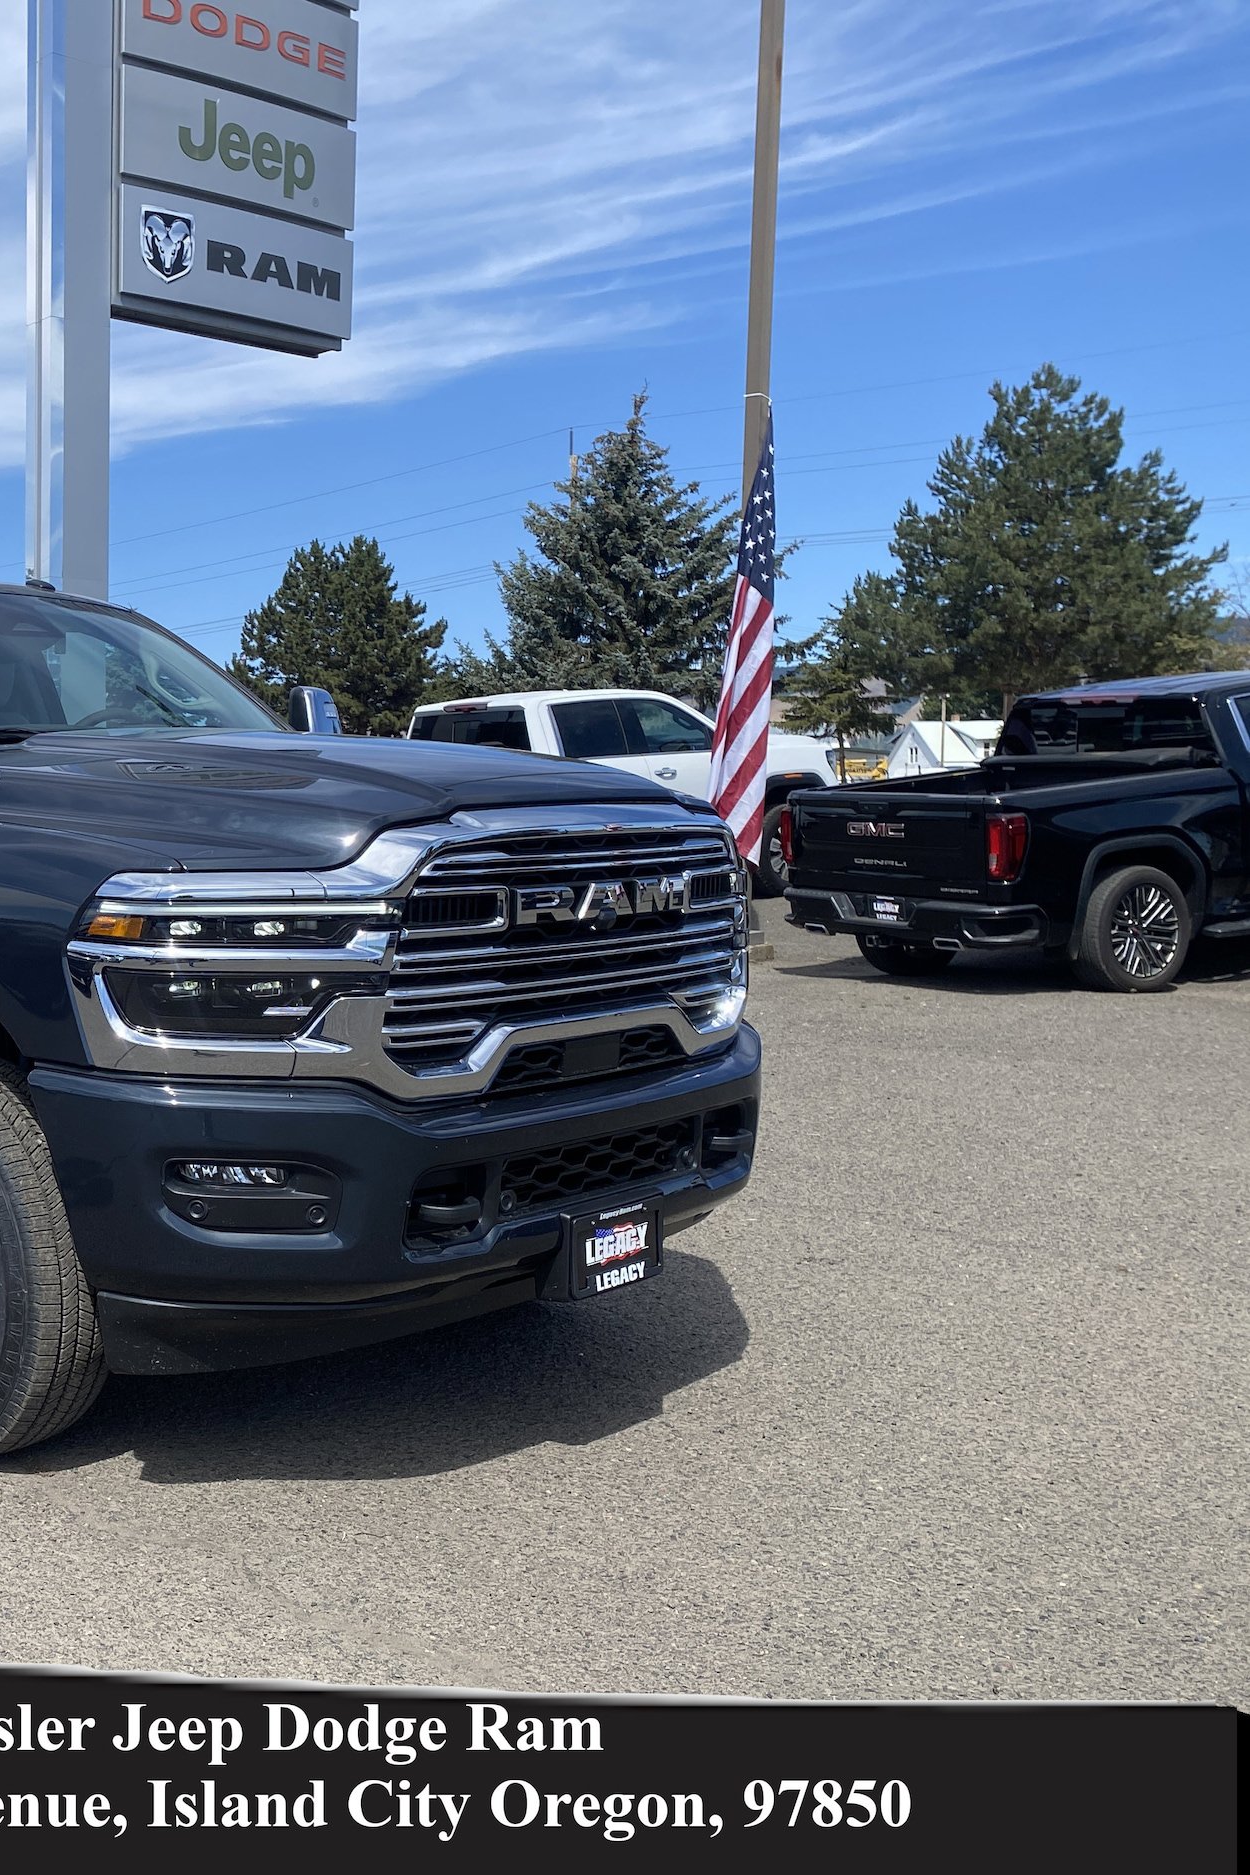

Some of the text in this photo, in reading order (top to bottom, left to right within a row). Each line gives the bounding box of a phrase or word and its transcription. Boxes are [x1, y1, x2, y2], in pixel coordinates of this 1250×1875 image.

[142, 0, 347, 80] DODGE
[178, 98, 316, 200] Jeep
[206, 239, 341, 302] RAM
[847, 821, 905, 838] GMC
[854, 857, 907, 867] DENALI
[516, 877, 686, 925] RAM
[586, 1224, 648, 1264] LEGACY
[596, 1261, 645, 1292] LEGACY
